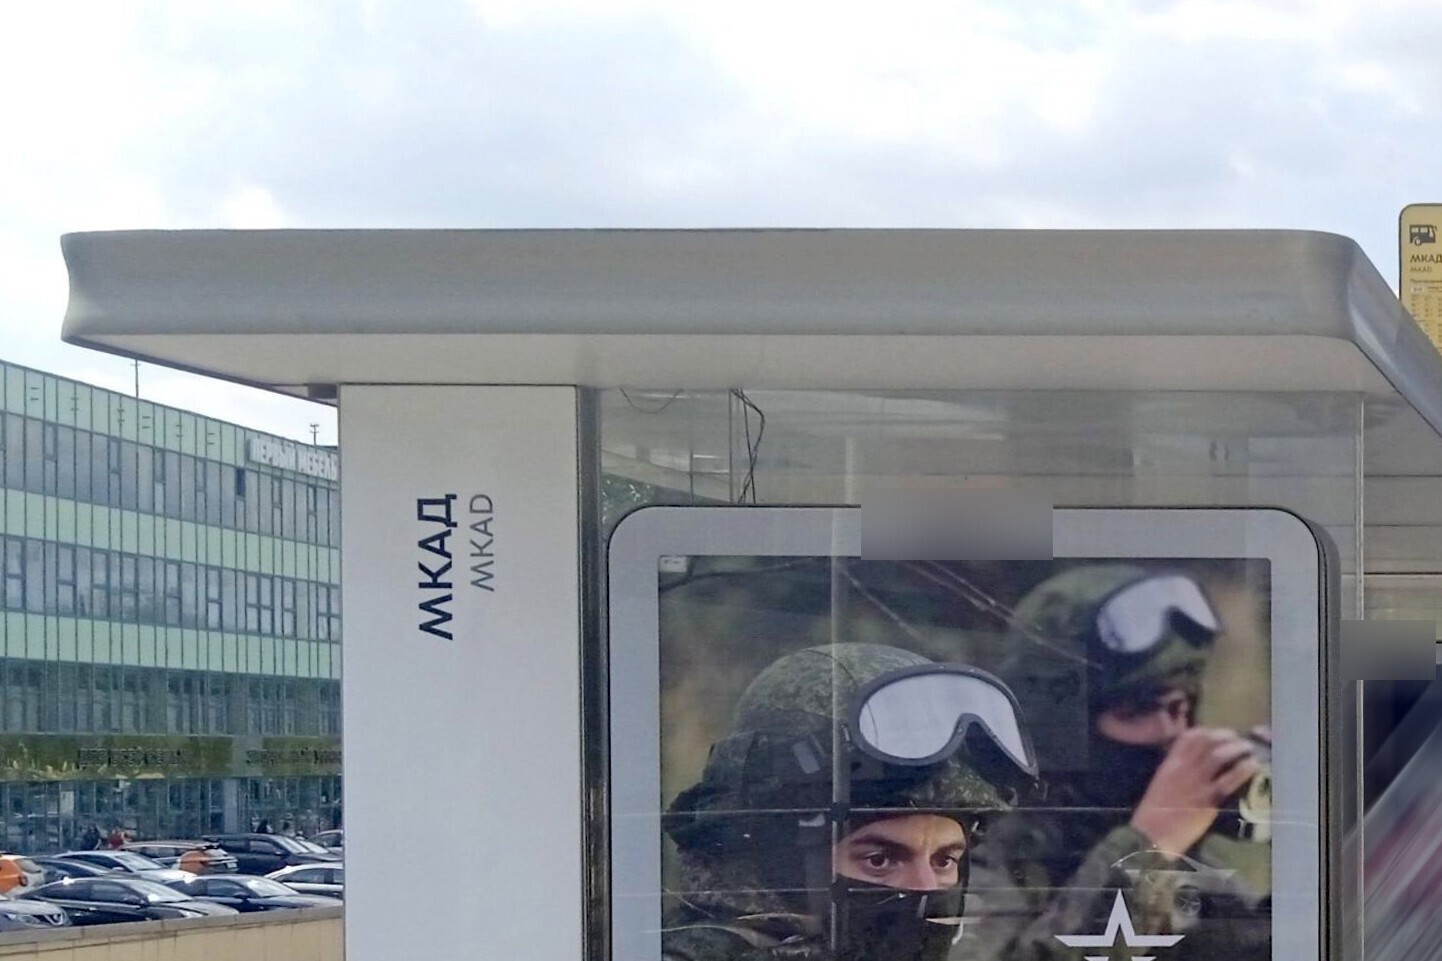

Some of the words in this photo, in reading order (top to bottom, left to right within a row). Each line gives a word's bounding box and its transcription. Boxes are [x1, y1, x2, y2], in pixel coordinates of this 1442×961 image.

[1410, 254, 1442, 263] МКАД
[417, 493, 457, 641] МКАД
[469, 493, 494, 592] MKAD
